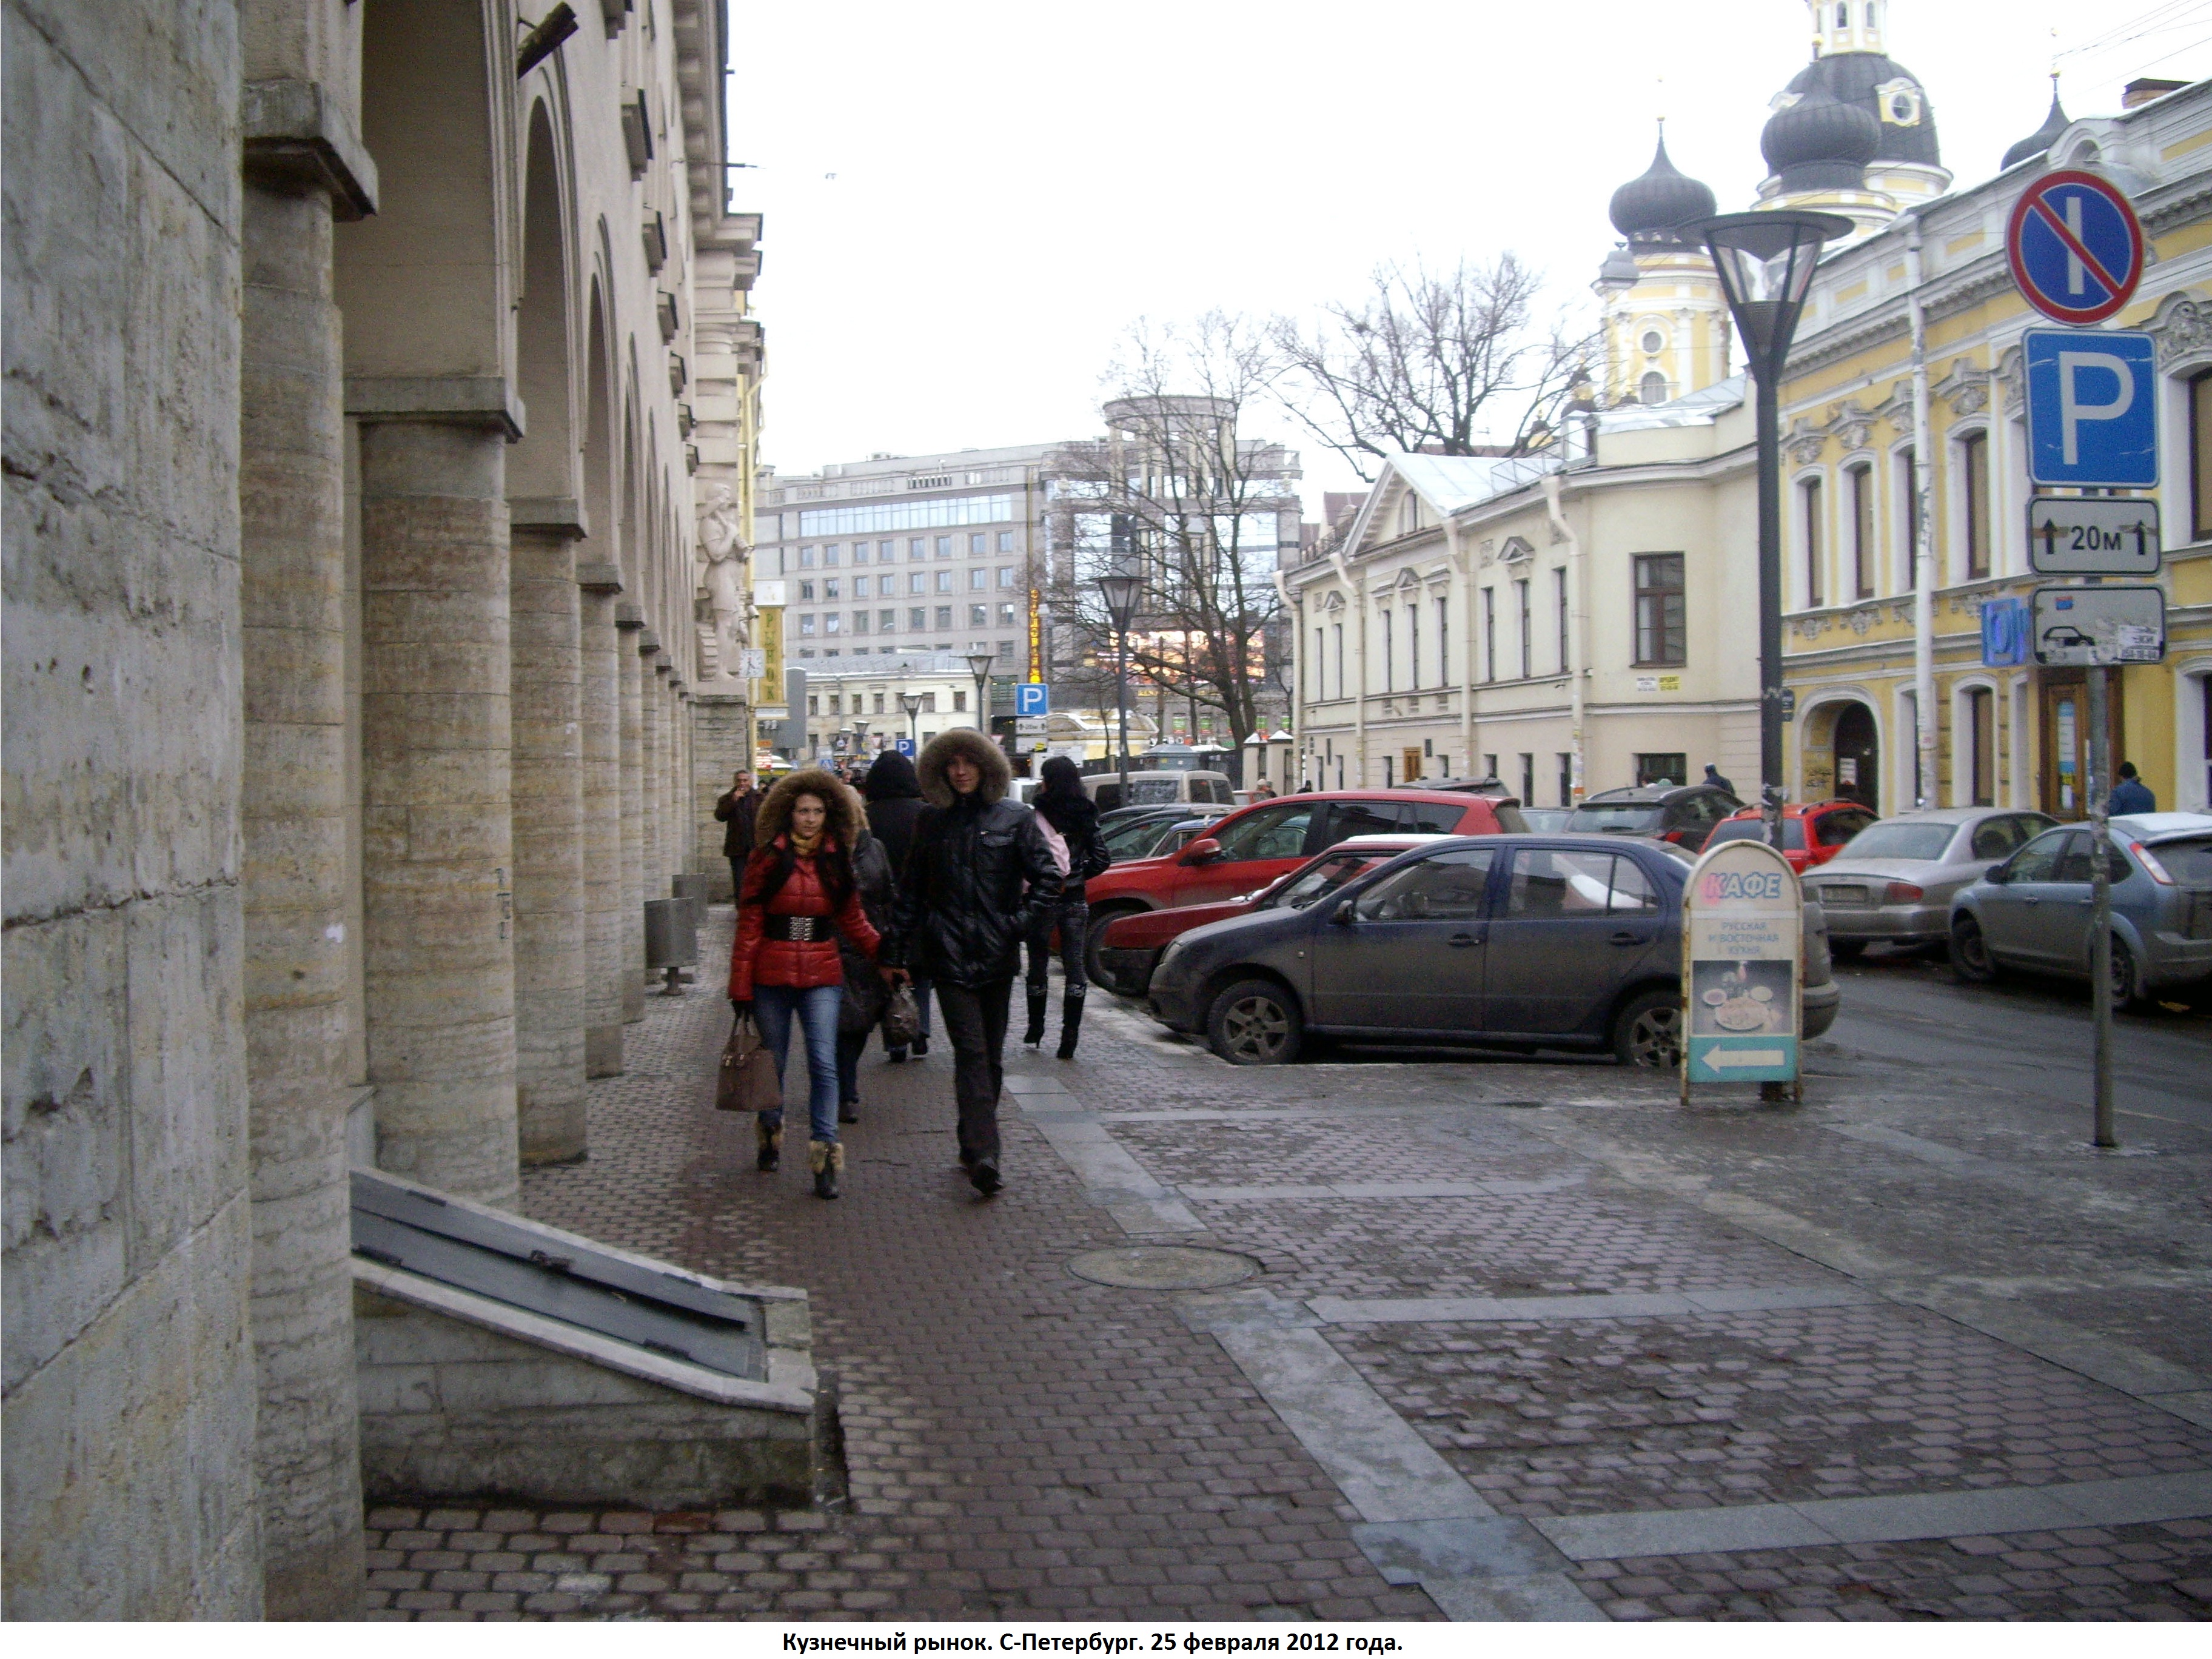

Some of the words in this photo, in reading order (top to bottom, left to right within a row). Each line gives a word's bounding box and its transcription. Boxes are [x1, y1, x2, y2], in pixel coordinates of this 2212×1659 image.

[2059, 350, 2134, 465] P
[765, 613, 776, 700] РЫНОК
[1023, 688, 1042, 712] P
[898, 741, 909, 751] P
[1706, 872, 1782, 899] КАФЕ
[1720, 934, 1779, 942] ВОСТОЧНАЯ
[1721, 922, 1767, 930] РУССКАЯ
